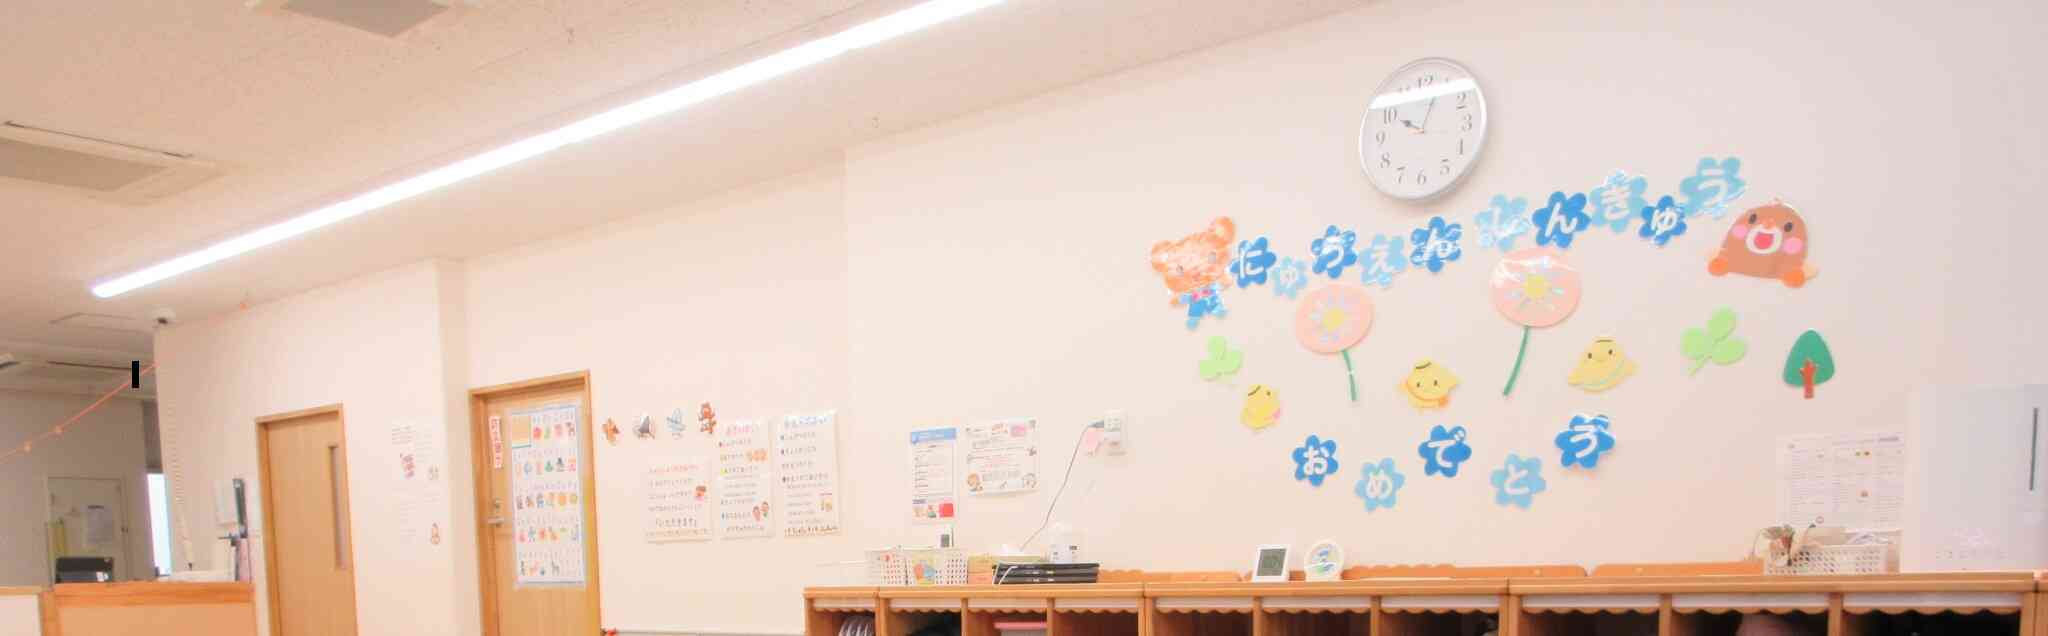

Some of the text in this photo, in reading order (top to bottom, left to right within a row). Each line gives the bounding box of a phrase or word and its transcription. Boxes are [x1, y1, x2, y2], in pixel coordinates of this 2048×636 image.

[1457, 92, 1467, 110] 2
[1383, 107, 1398, 125] 10
[1462, 112, 1472, 132] 3
[1375, 130, 1386, 146] 9
[1380, 152, 1391, 169] 8
[1440, 158, 1450, 176] 5
[1397, 166, 1406, 185] 7
[1417, 169, 1427, 185] 6
[1304, 425, 1598, 500] おめでとう
